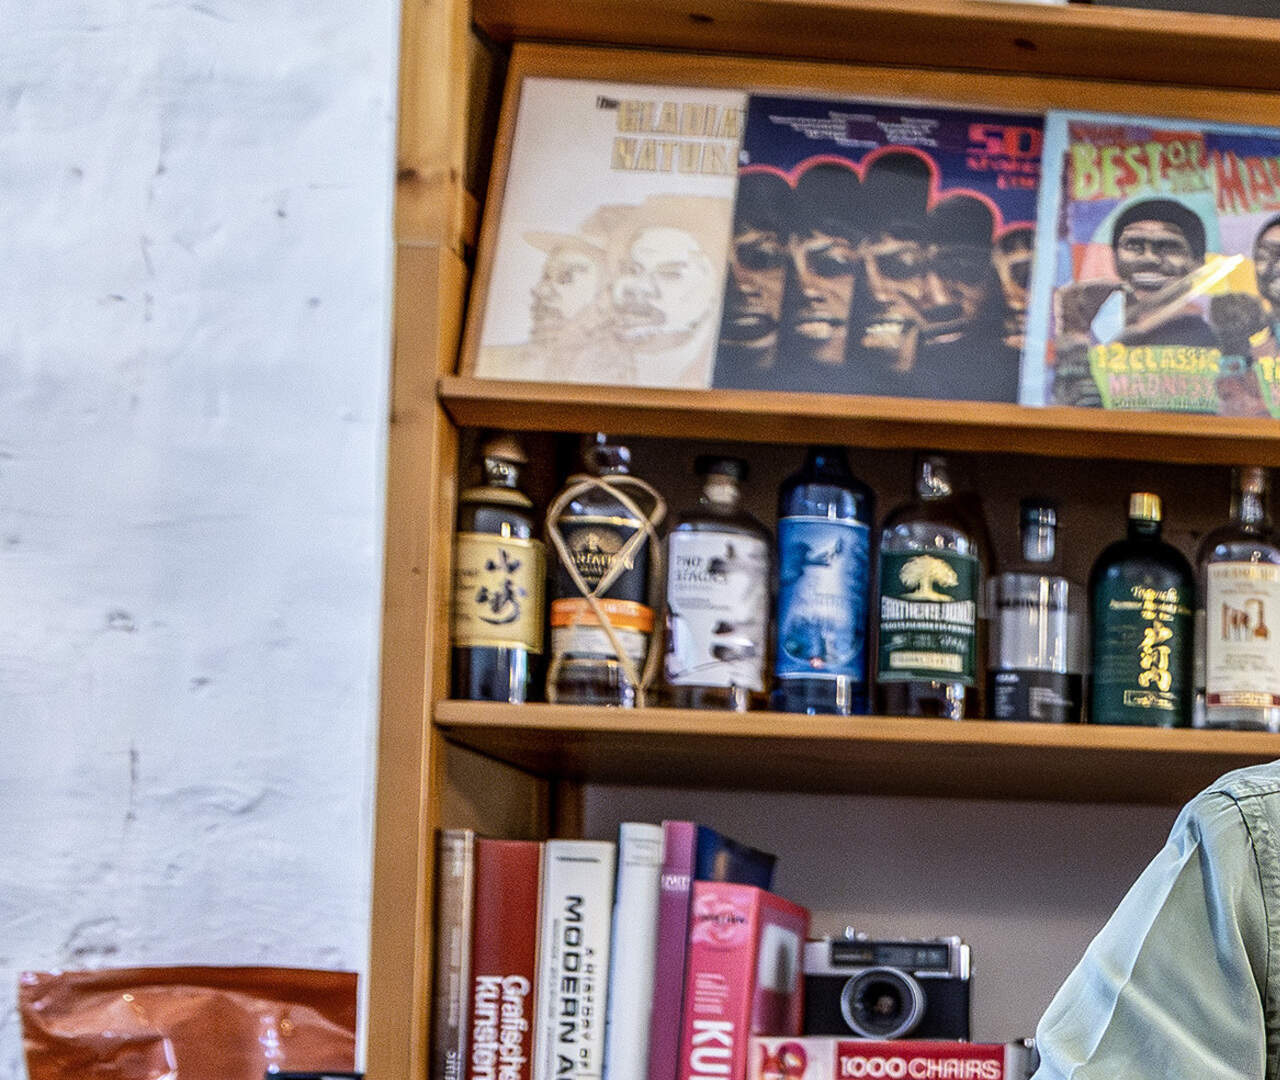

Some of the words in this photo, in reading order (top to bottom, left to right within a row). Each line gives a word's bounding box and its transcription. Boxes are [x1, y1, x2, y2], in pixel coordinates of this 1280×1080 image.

[1070, 141, 1162, 198] BEST
[558, 895, 585, 1044] MODERN
[840, 1056, 907, 1079] 1000
[908, 1057, 1001, 1080] CHAIRS
